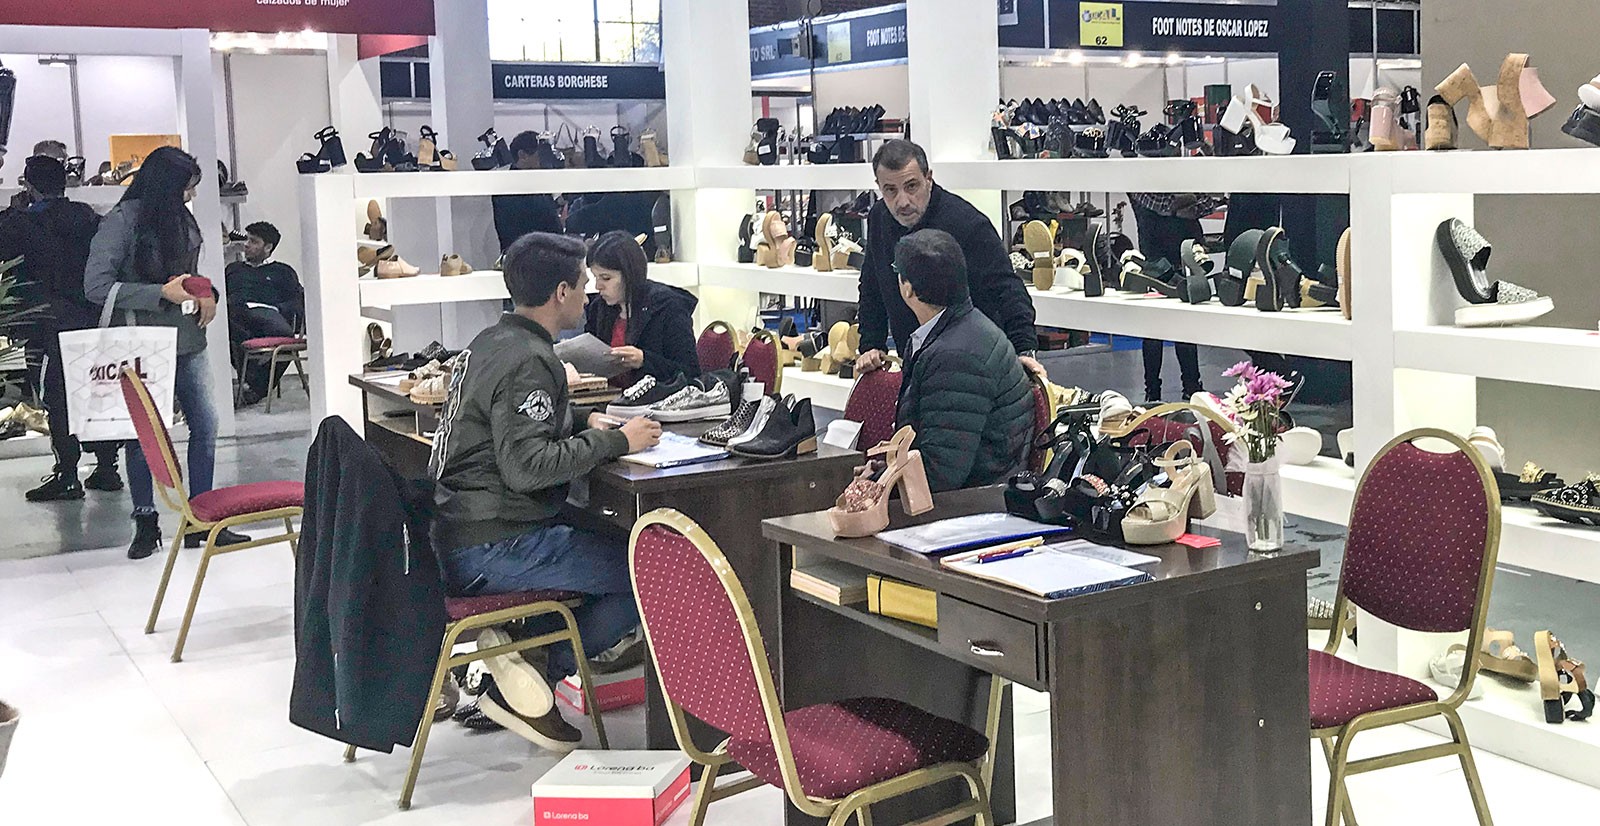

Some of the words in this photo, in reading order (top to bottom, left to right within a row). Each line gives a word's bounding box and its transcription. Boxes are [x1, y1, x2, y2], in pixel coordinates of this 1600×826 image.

[1152, 17, 1175, 36] FOOT
[1175, 18, 1203, 36] NOTES
[1203, 18, 1215, 36] DE
[1216, 19, 1243, 37] OSCAR
[1243, 19, 1269, 37] LOPEZ
[866, 29, 880, 48] FOOT
[880, 26, 897, 46] NOTES
[898, 25, 906, 43] DE
[1095, 36, 1108, 45] 62
[760, 45, 775, 61] SRL
[504, 75, 555, 88] CARTERAS
[557, 75, 608, 88] BORGHESE
[551, 812, 578, 820] Lorena
[578, 812, 589, 820] ba
